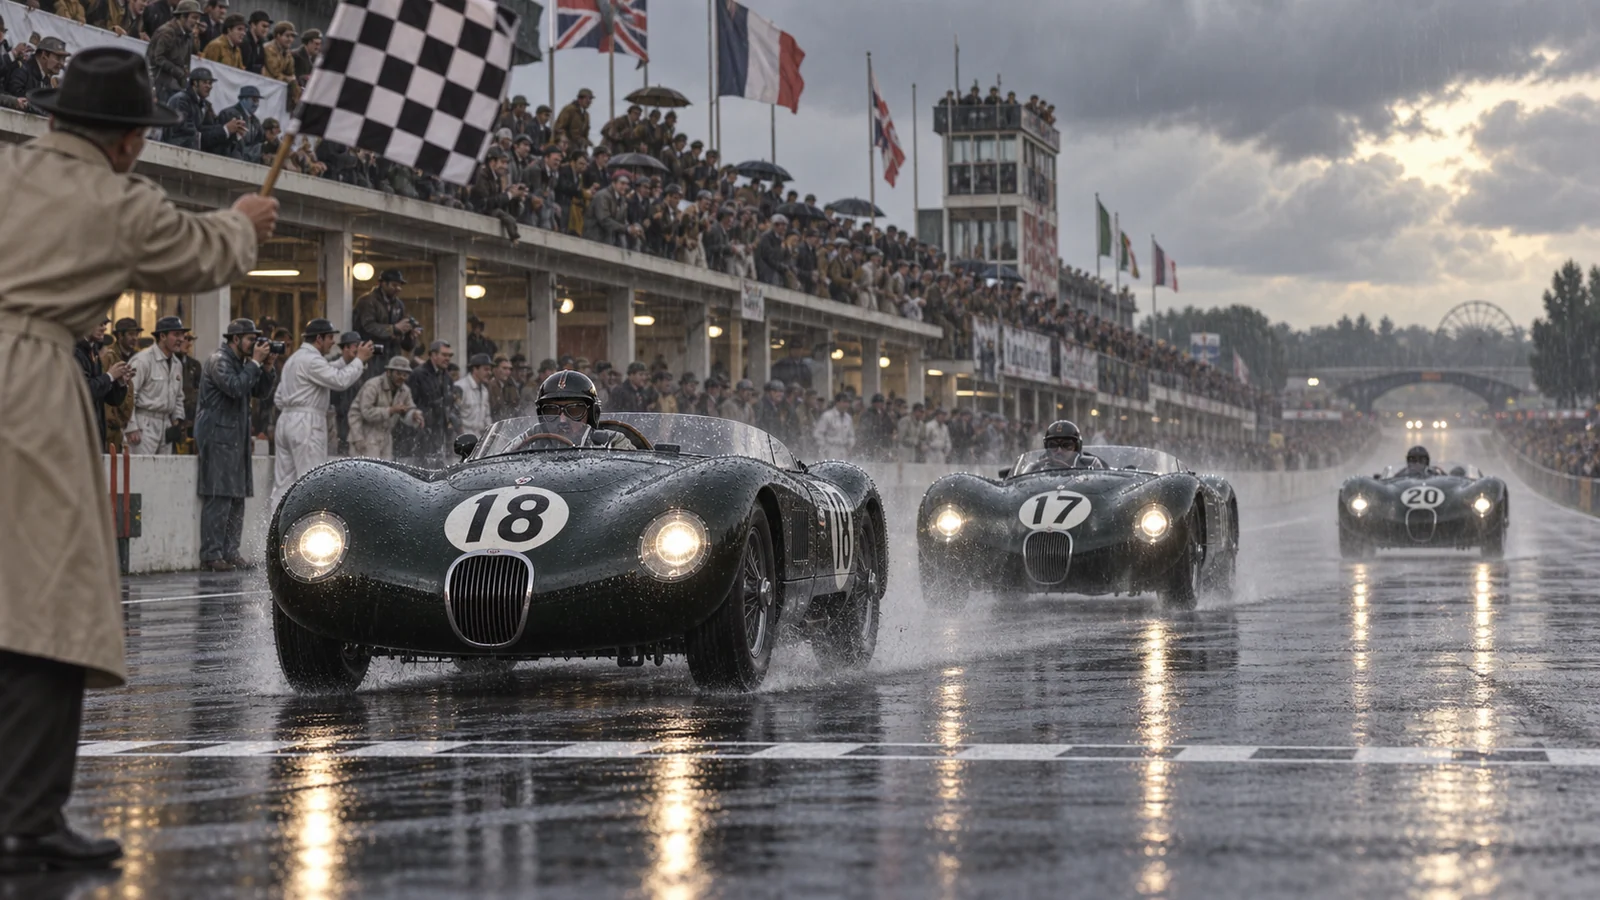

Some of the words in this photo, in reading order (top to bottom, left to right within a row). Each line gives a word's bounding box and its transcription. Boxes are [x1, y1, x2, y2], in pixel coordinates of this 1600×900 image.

[1033, 496, 1083, 524] 17
[1407, 489, 1438, 504] 20
[465, 494, 550, 543] 18
[823, 490, 850, 569] 18
